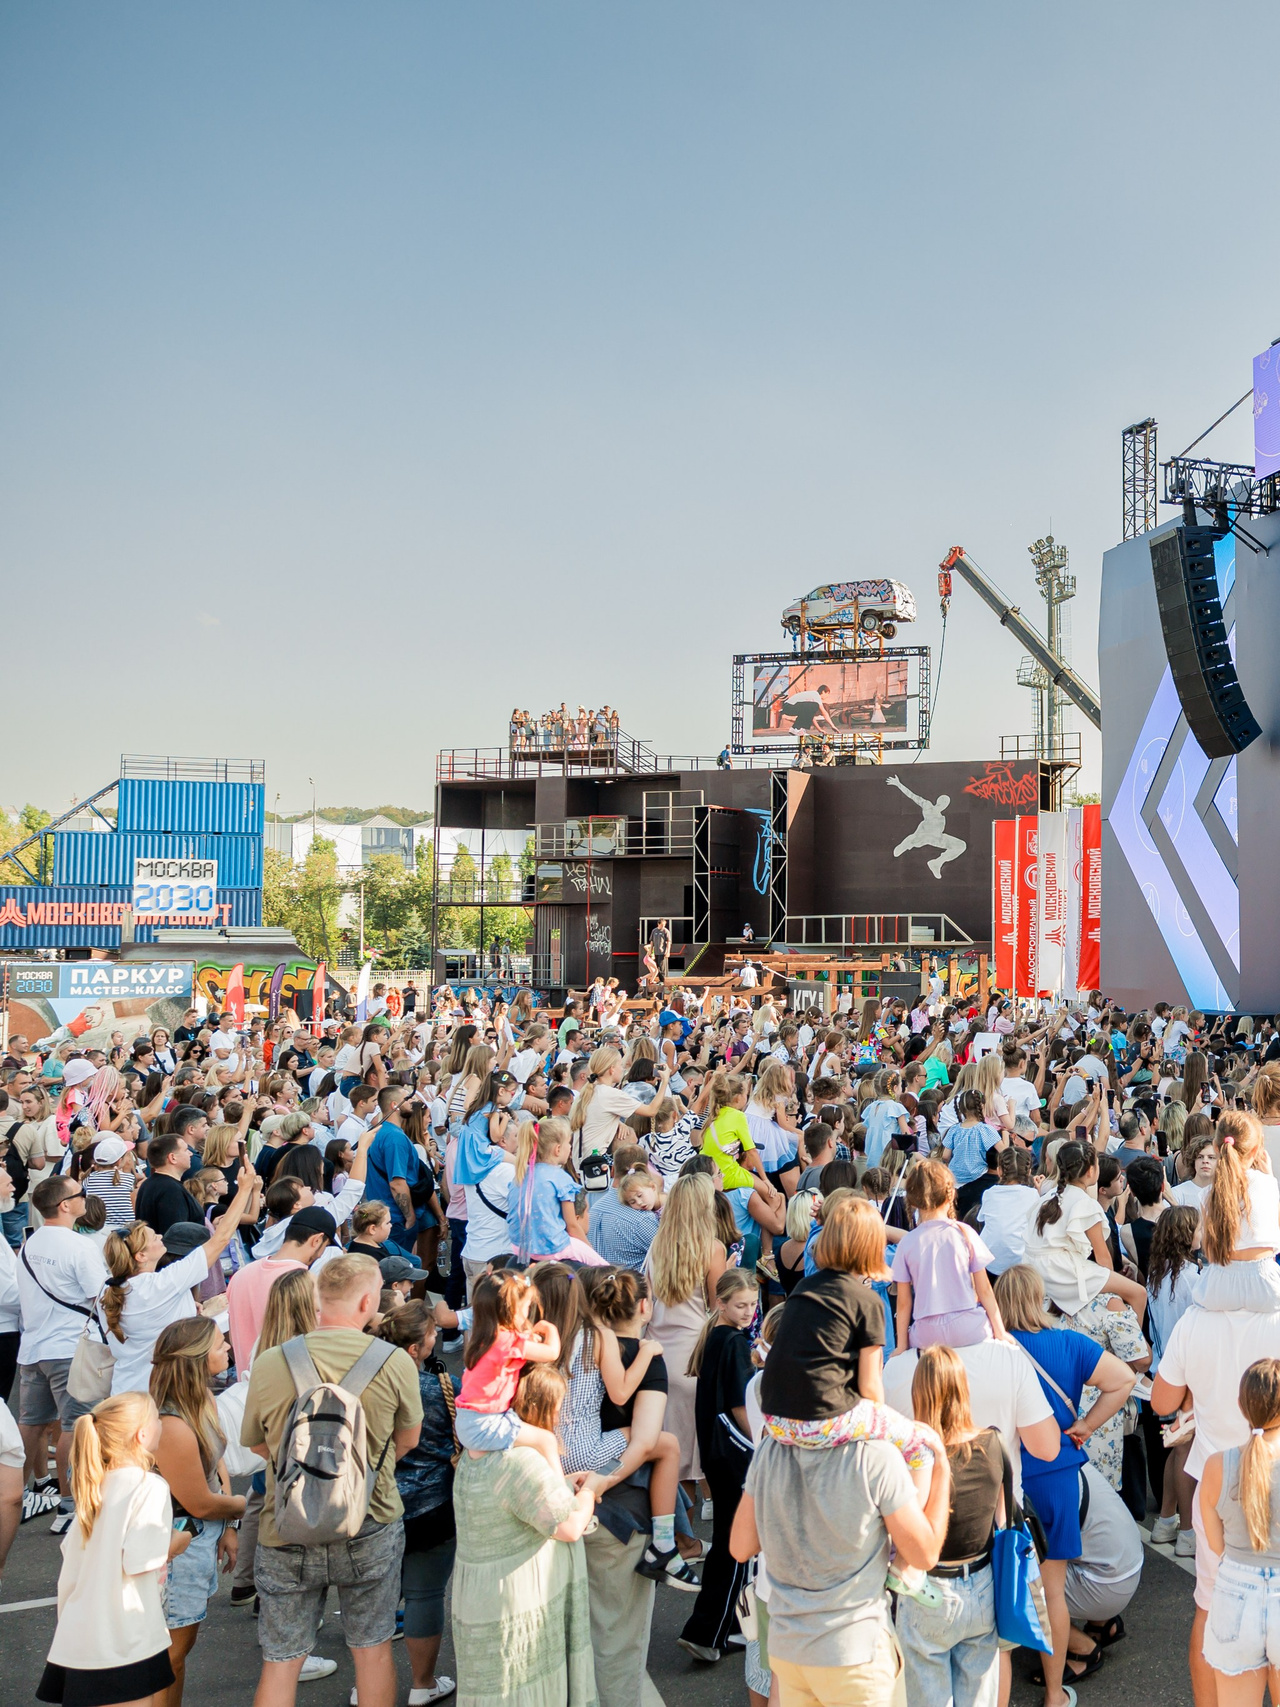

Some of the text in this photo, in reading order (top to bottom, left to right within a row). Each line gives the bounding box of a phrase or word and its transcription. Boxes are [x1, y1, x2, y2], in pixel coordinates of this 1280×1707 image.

[137, 861, 214, 878] МОСКВА
[998, 860, 1012, 924] МОСКОВСКИЙ
[1043, 853, 1057, 921] МОСКОВСКИЙ
[135, 884, 213, 912] 2030
[1027, 899, 1036, 988] ГРАДОСТРОИТЕЛЬНЫЙ
[16, 971, 53, 980] МОСКВА
[70, 969, 185, 984] ПАРКУР
[16, 980, 53, 993] 2030
[70, 985, 184, 995] МАСТЕР-КЛАСС
